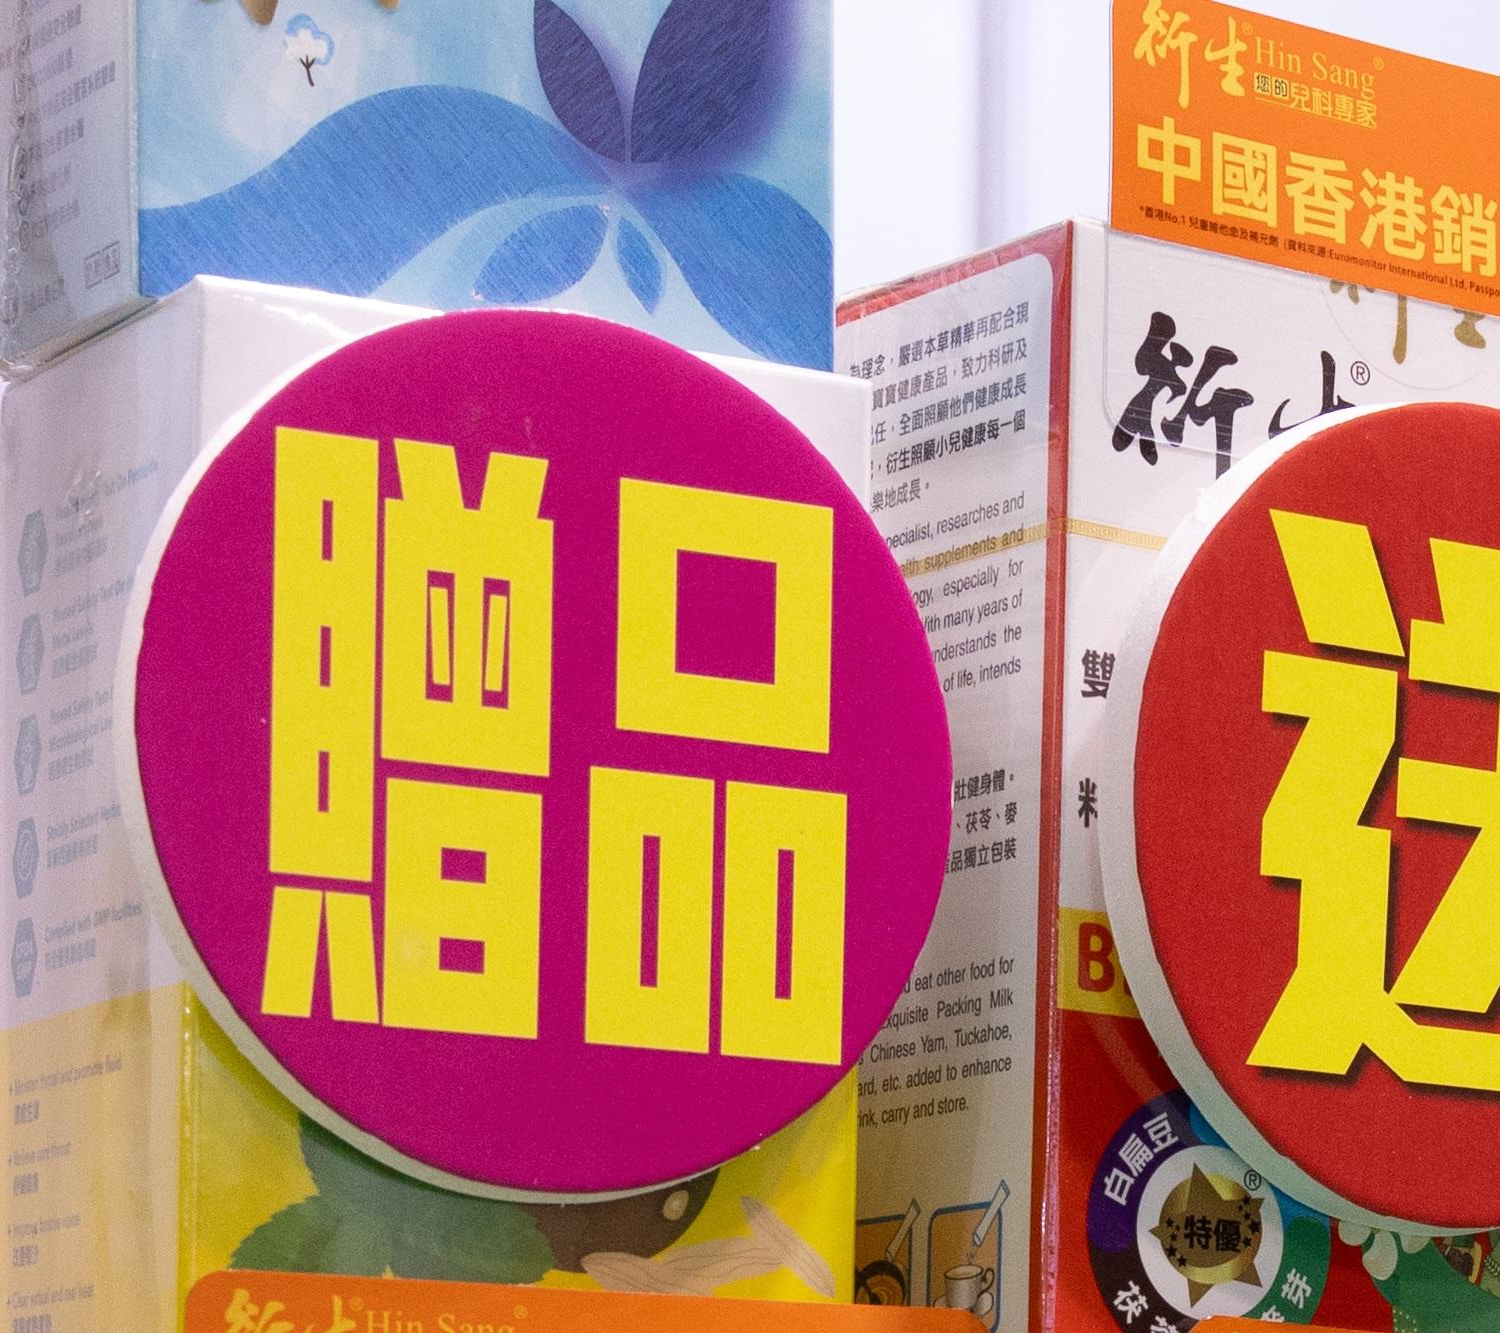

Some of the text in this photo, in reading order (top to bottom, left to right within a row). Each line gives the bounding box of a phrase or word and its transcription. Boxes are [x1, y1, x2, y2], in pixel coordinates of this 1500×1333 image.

[1253, 35, 1377, 98] Hin Sang
[936, 491, 1025, 535] researches and
[261, 426, 848, 1066] 贈品
